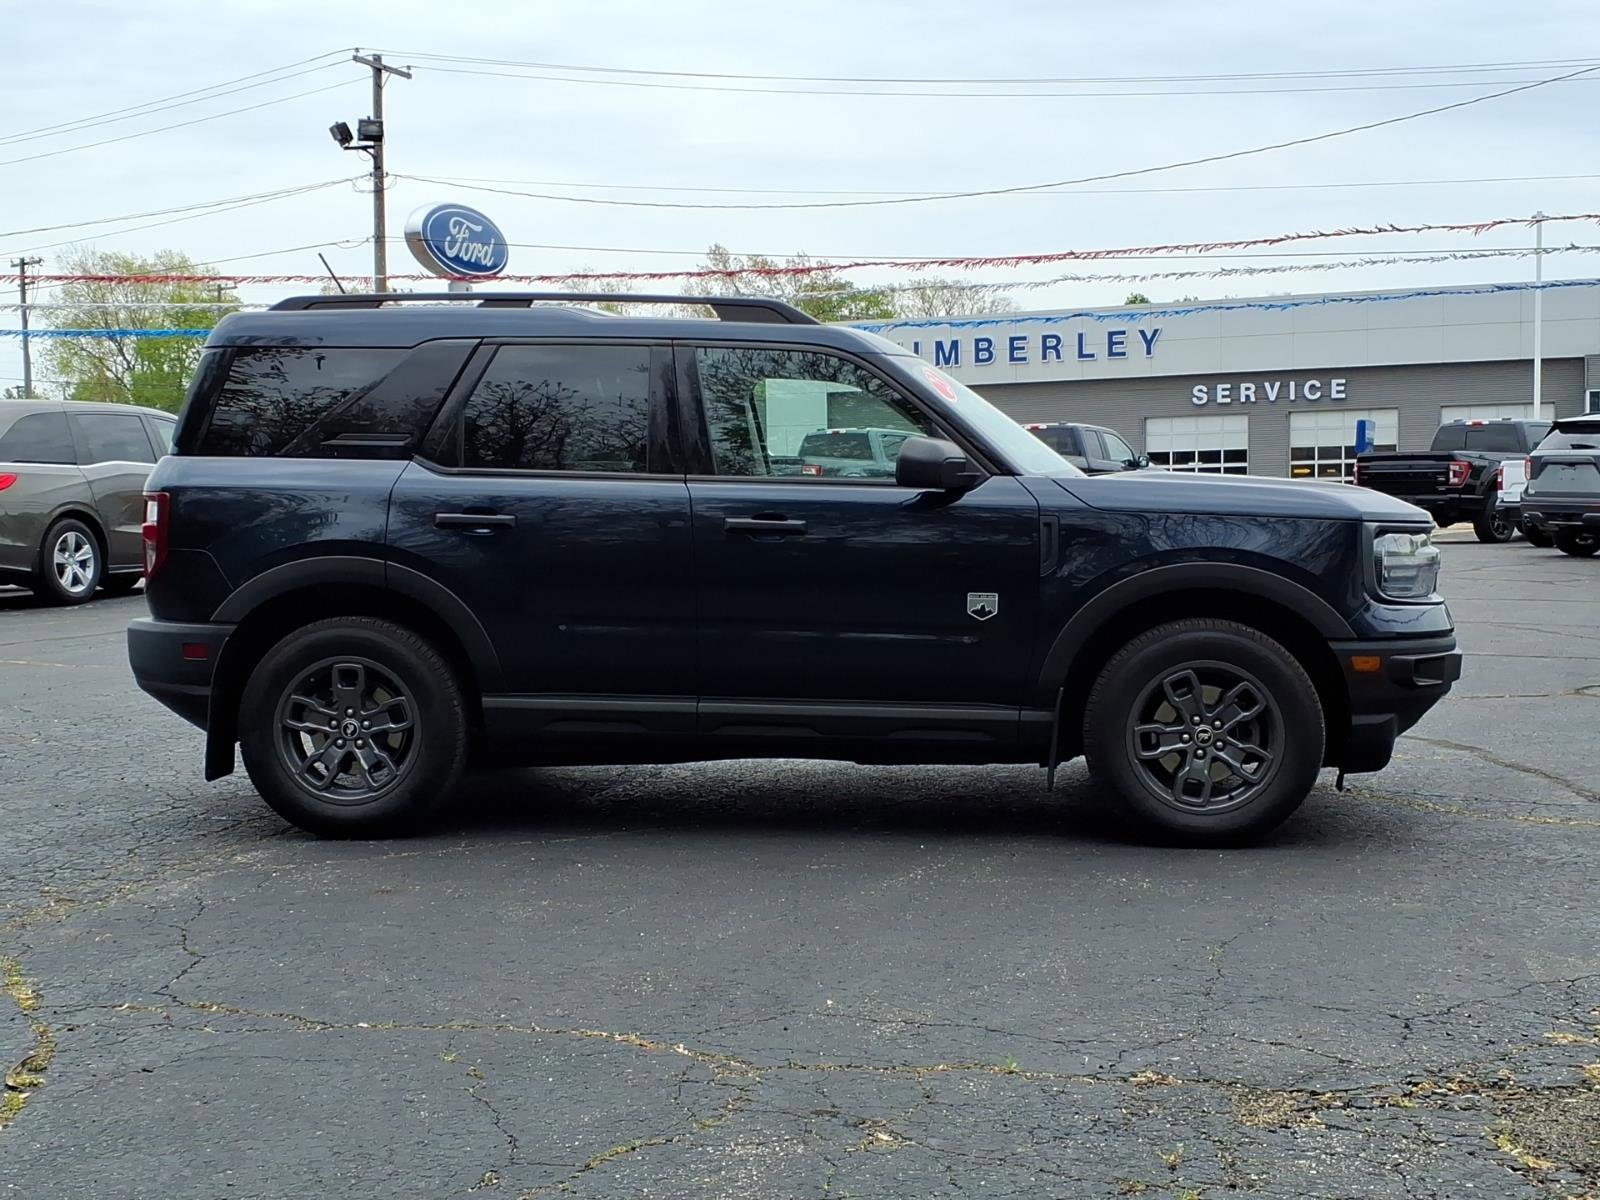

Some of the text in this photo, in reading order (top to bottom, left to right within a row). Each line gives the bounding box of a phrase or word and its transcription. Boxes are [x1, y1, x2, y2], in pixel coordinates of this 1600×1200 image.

[444, 216, 495, 267] Ford
[898, 328, 1161, 367] IMBERLEY
[1192, 379, 1347, 405] SERVICE
